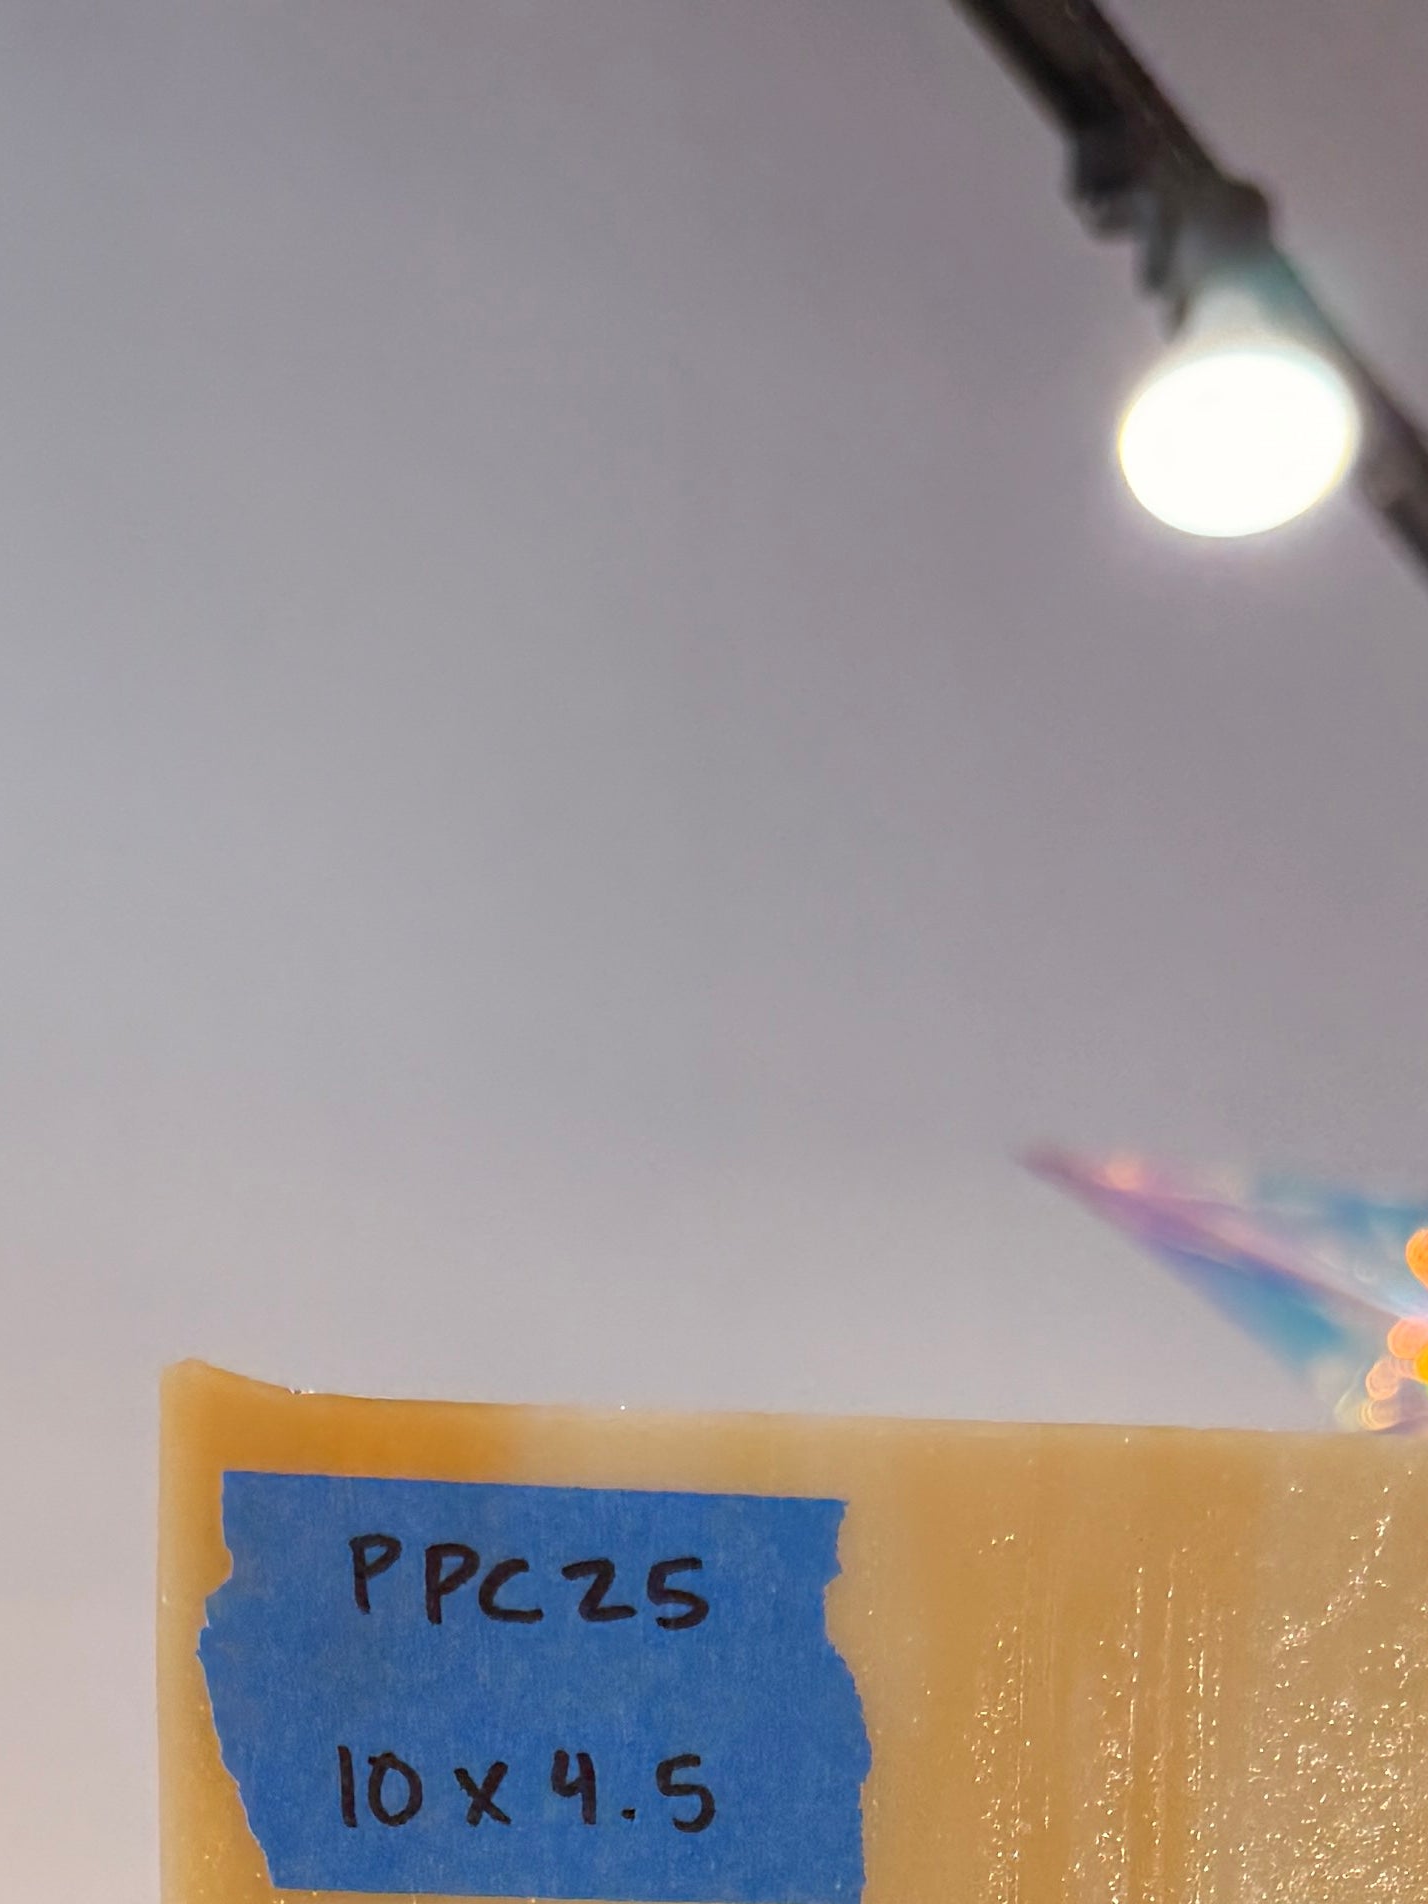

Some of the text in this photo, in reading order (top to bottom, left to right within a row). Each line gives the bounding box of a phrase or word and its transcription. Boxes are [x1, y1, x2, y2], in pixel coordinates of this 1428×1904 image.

[348, 1532, 710, 1631] PPC25
[337, 1744, 424, 1829] 10
[550, 1748, 717, 1834] 4.5
